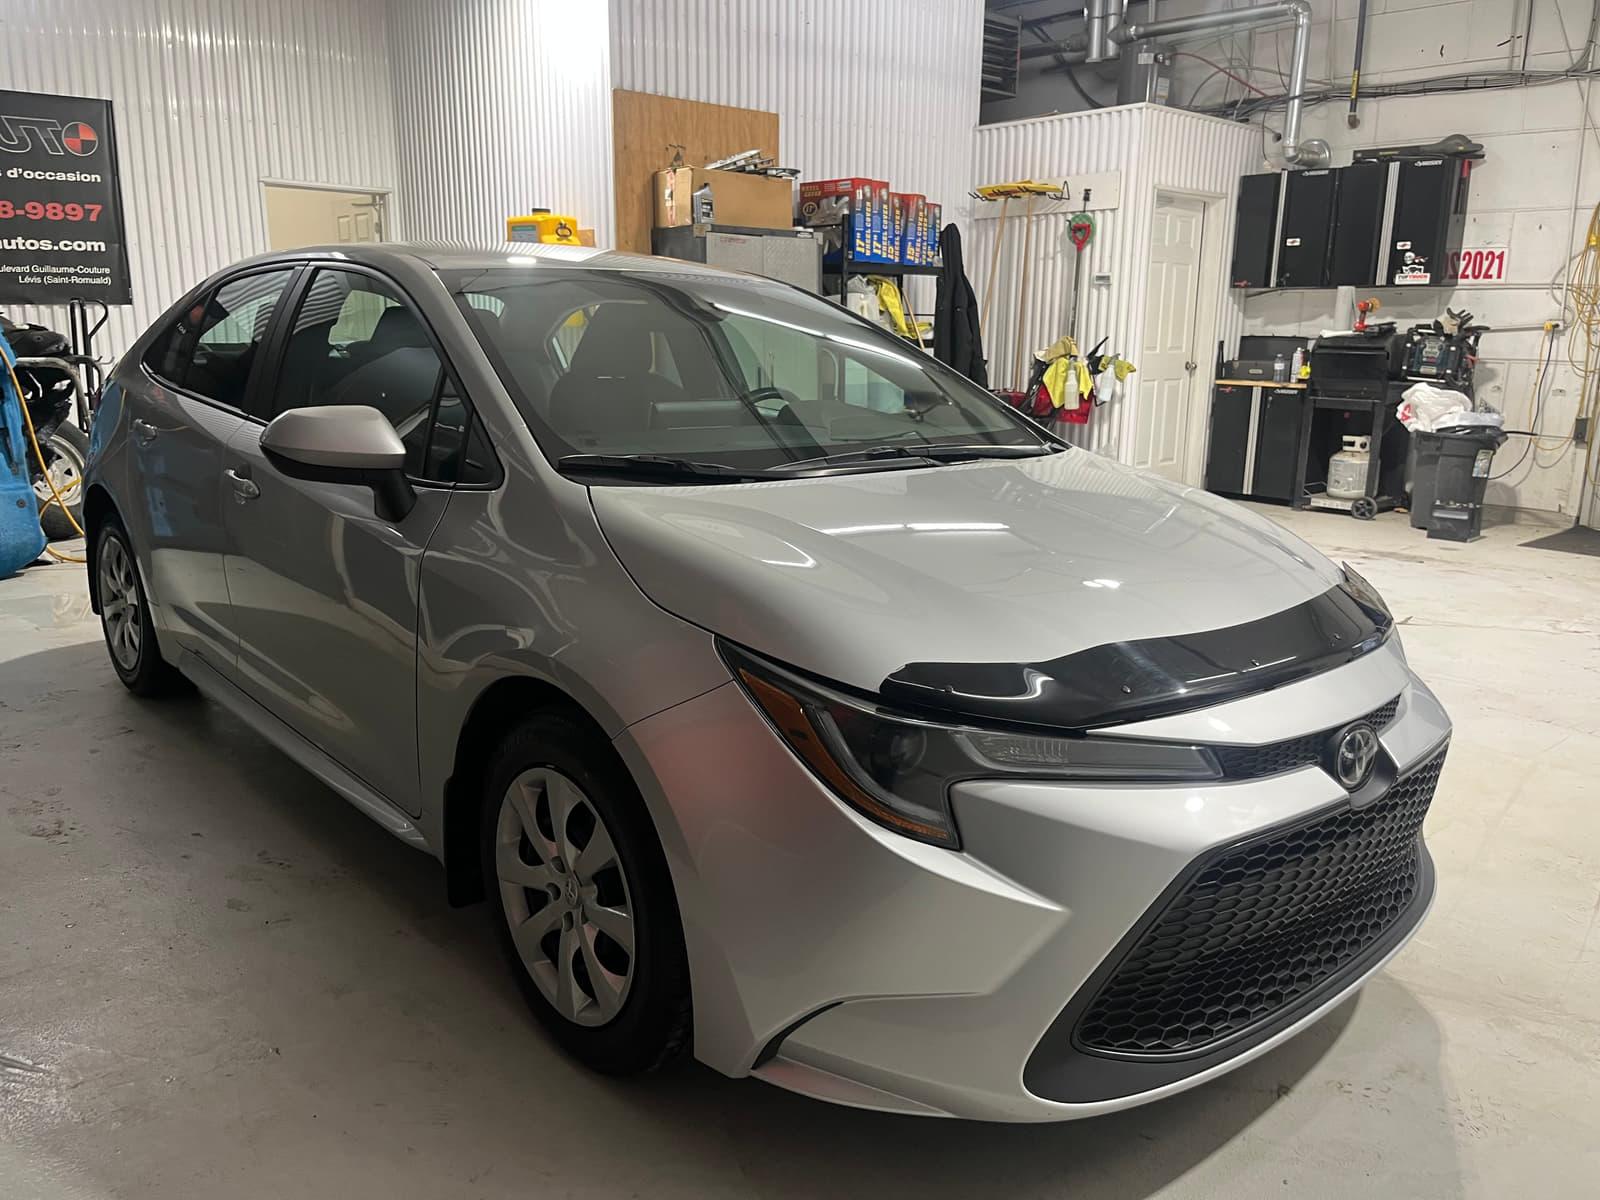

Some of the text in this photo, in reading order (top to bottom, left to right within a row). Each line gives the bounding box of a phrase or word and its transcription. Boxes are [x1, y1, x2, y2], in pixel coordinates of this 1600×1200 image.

[6, 167, 102, 183] d'occasion
[0, 200, 103, 222] 8-9897
[0, 236, 106, 252] utos.com
[31, 264, 111, 275] Guillaume-Couture
[1460, 250, 1505, 279] 2021
[18, 275, 112, 286] Lévis (Saint-Romuald)
